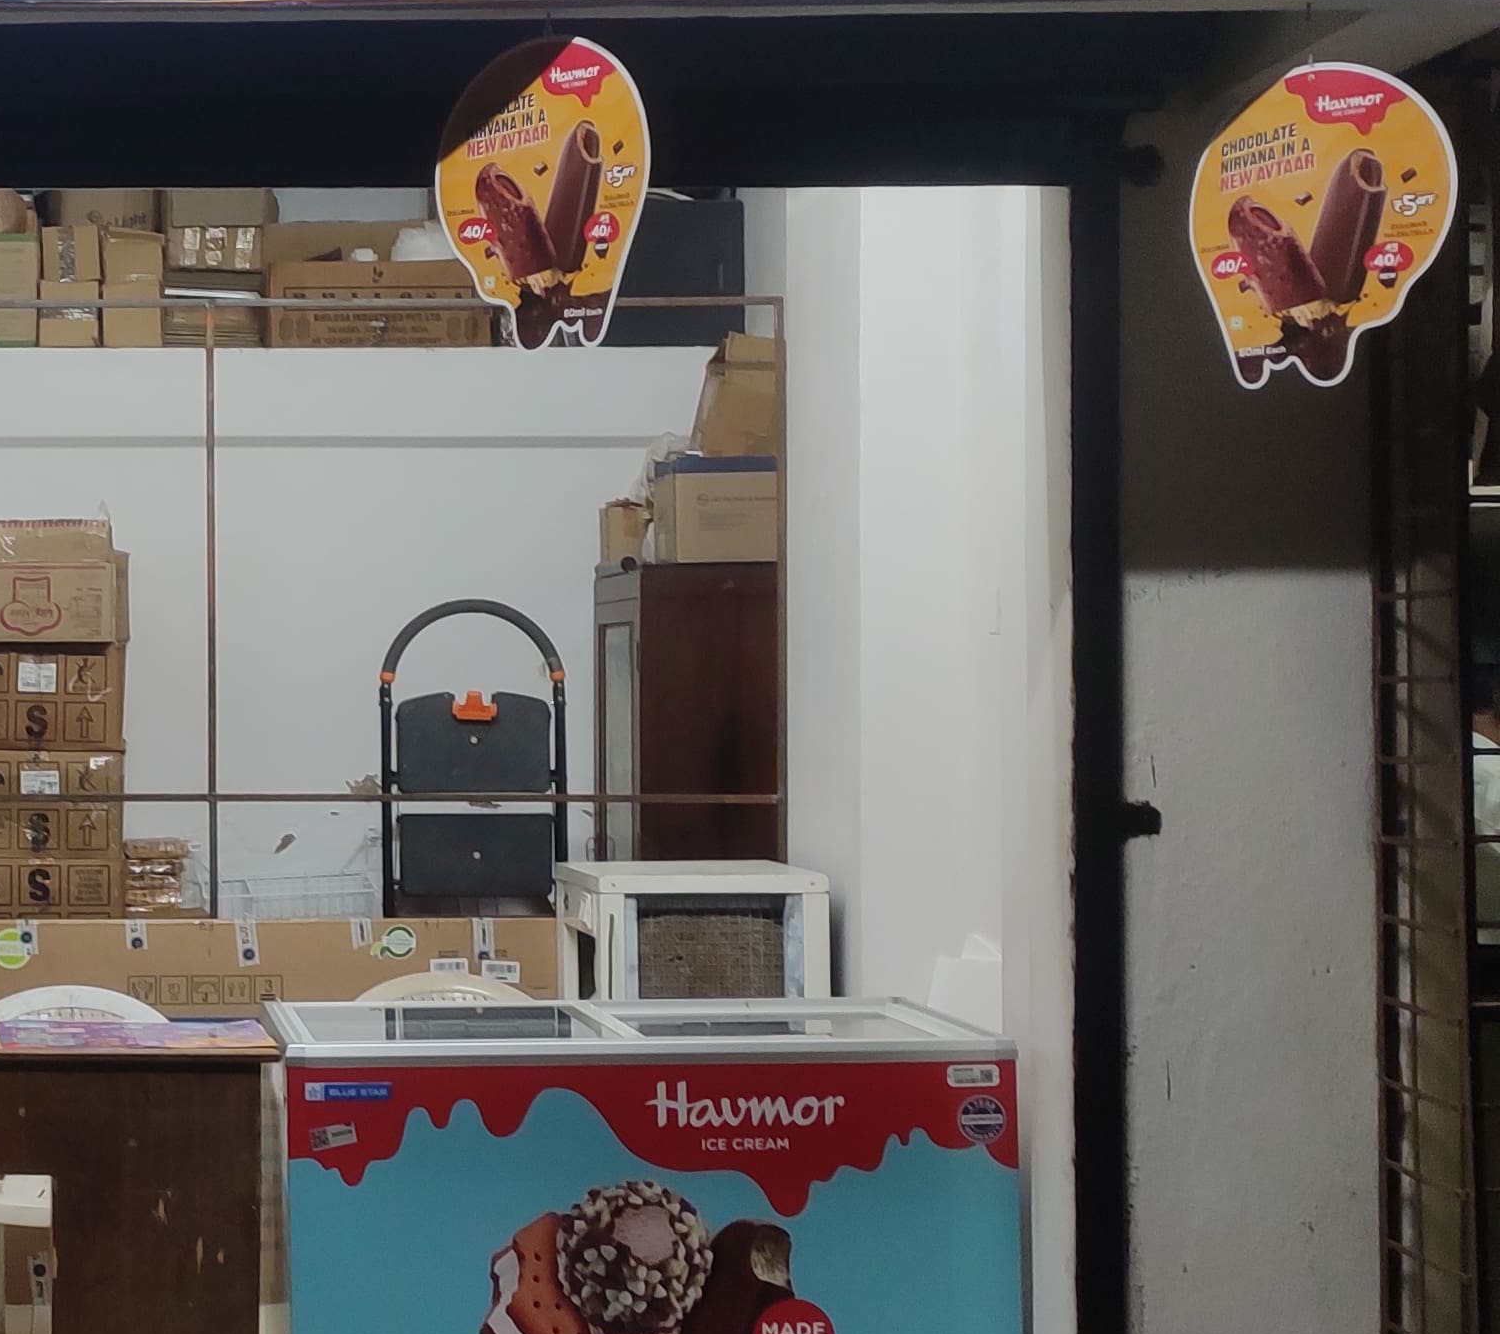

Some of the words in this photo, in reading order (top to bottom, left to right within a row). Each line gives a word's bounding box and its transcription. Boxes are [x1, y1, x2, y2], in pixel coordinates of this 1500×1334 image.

[549, 64, 601, 84] Havmor
[1314, 92, 1385, 113] Havmor
[467, 137, 497, 157] NEW
[501, 124, 550, 150] AVTAAR
[1221, 123, 1298, 157] CHOCOLATE
[1221, 146, 1276, 175] NIRVANA
[1282, 140, 1296, 157] IN
[1301, 137, 1311, 153] A
[1220, 171, 1254, 192] NEW
[1257, 153, 1316, 183] AVTAAR
[645, 1080, 845, 1129] Havmor
[701, 1137, 727, 1151] ICE
[732, 1137, 790, 1151] CREAM
